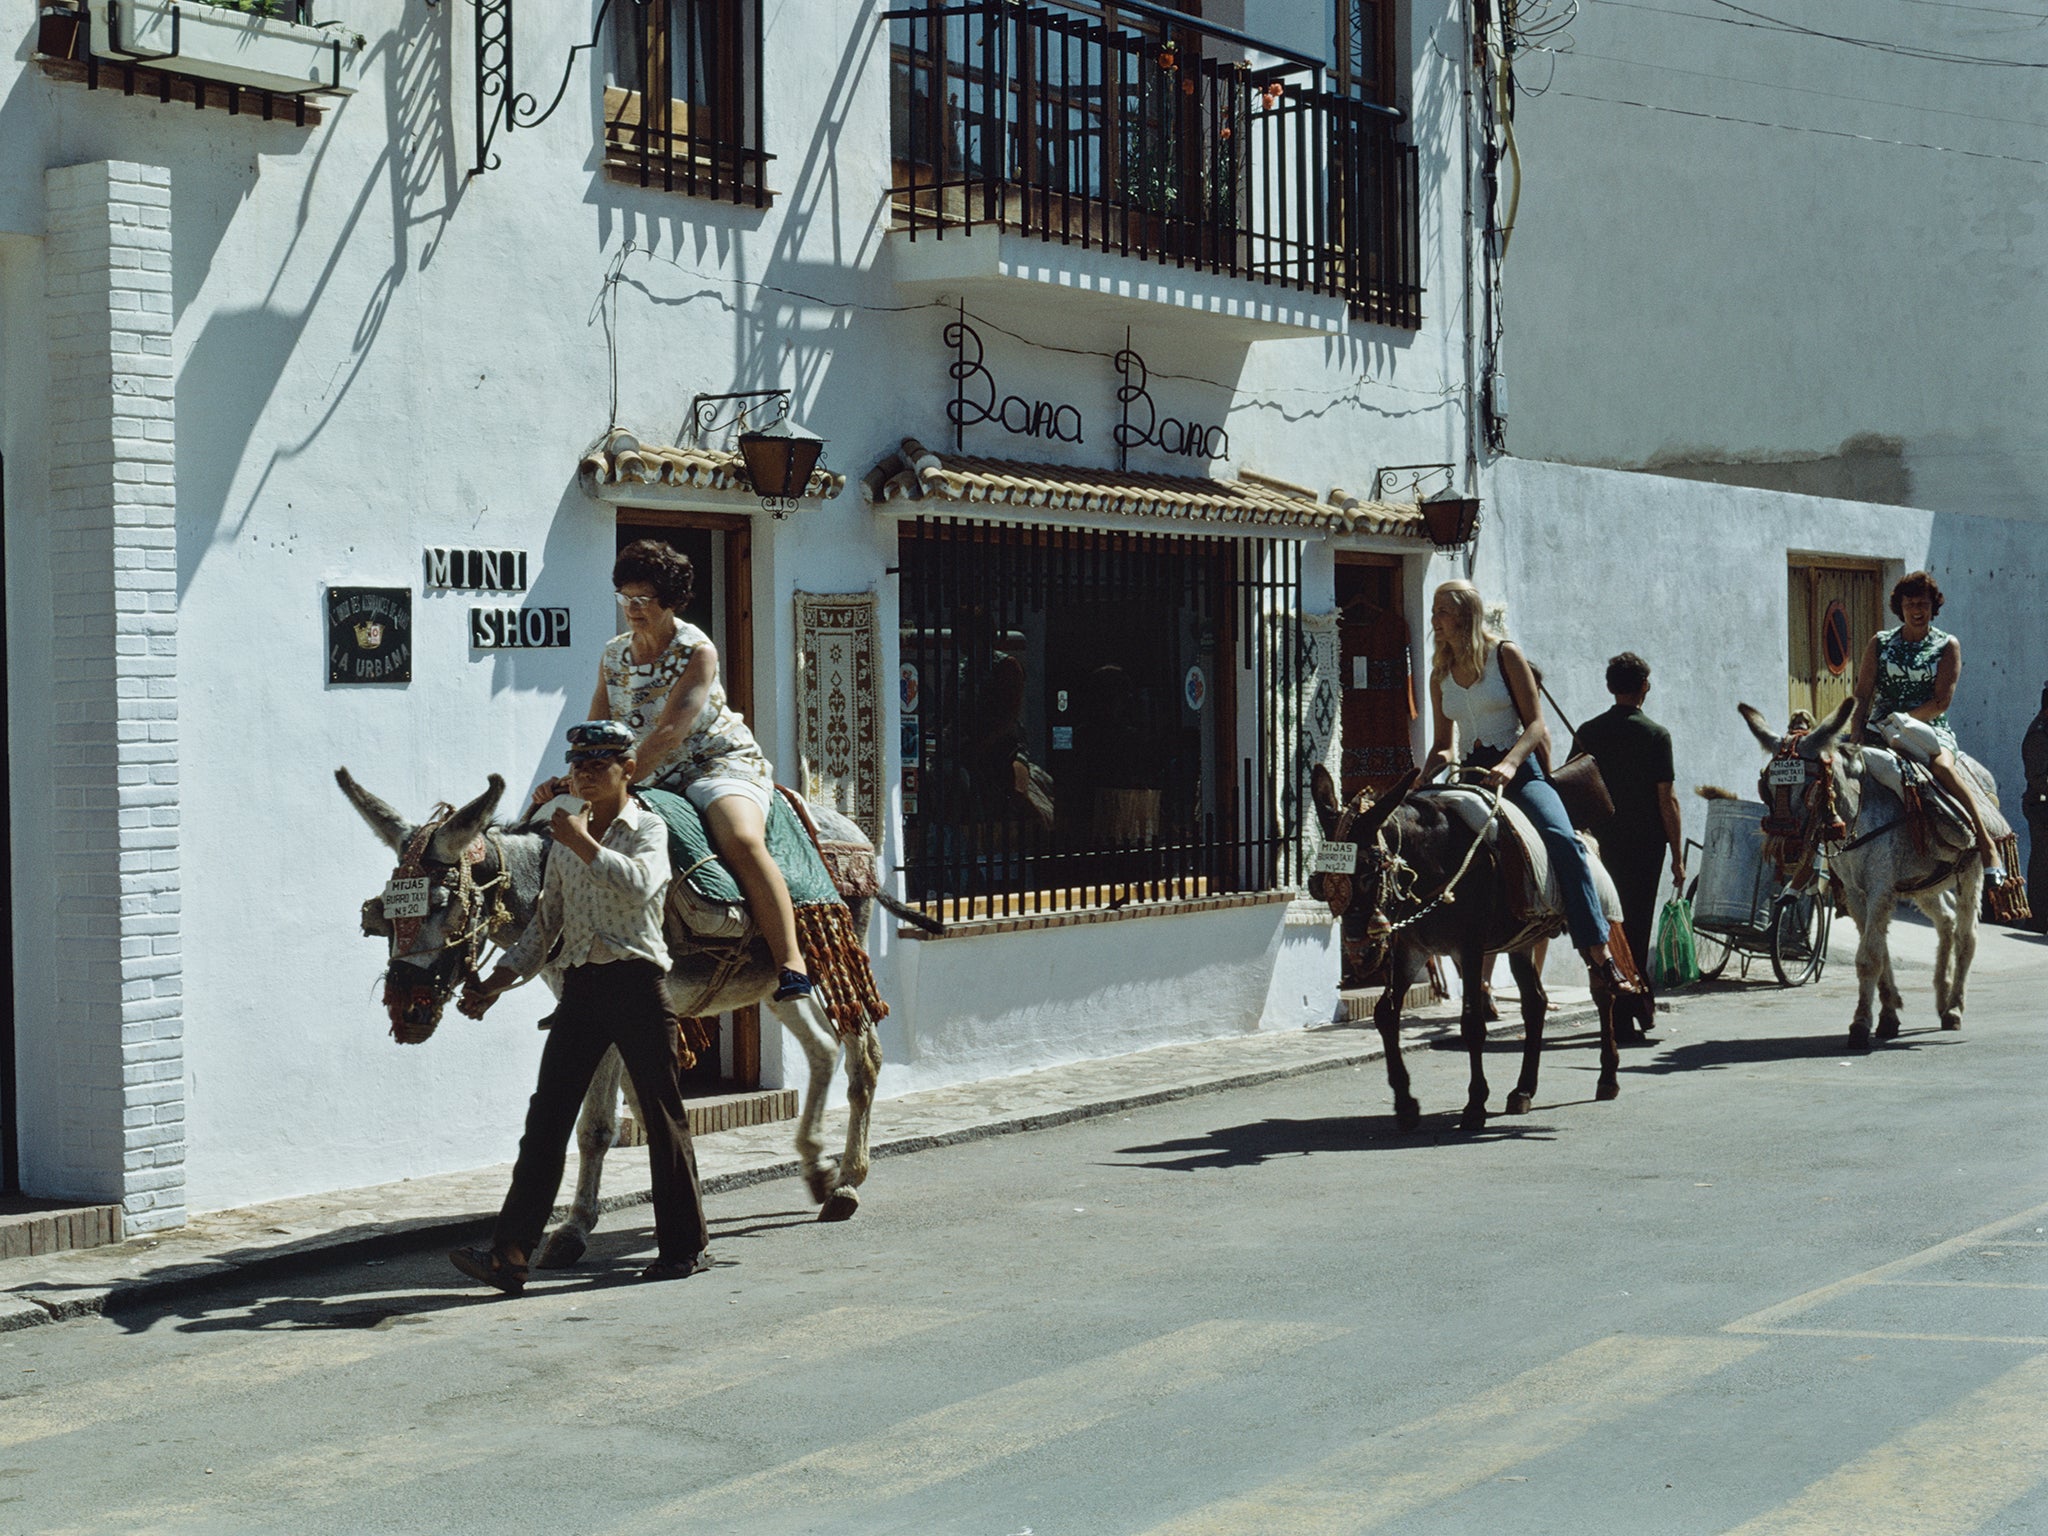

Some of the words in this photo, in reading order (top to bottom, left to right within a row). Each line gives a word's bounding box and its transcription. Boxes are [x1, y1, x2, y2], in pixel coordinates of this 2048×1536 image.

[428, 547, 522, 590] MINI
[476, 607, 570, 648] SHOP
[331, 643, 349, 672] LA
[356, 642, 411, 678] URBANA
[1774, 760, 1801, 768] MIJAS
[1321, 843, 1352, 853] MIJAS
[1317, 852, 1338, 862] BURRO
[1339, 853, 1354, 862] TAXI
[391, 879, 424, 891] MIJAS
[386, 893, 409, 905] BURRO
[411, 891, 427, 902] TAXI
